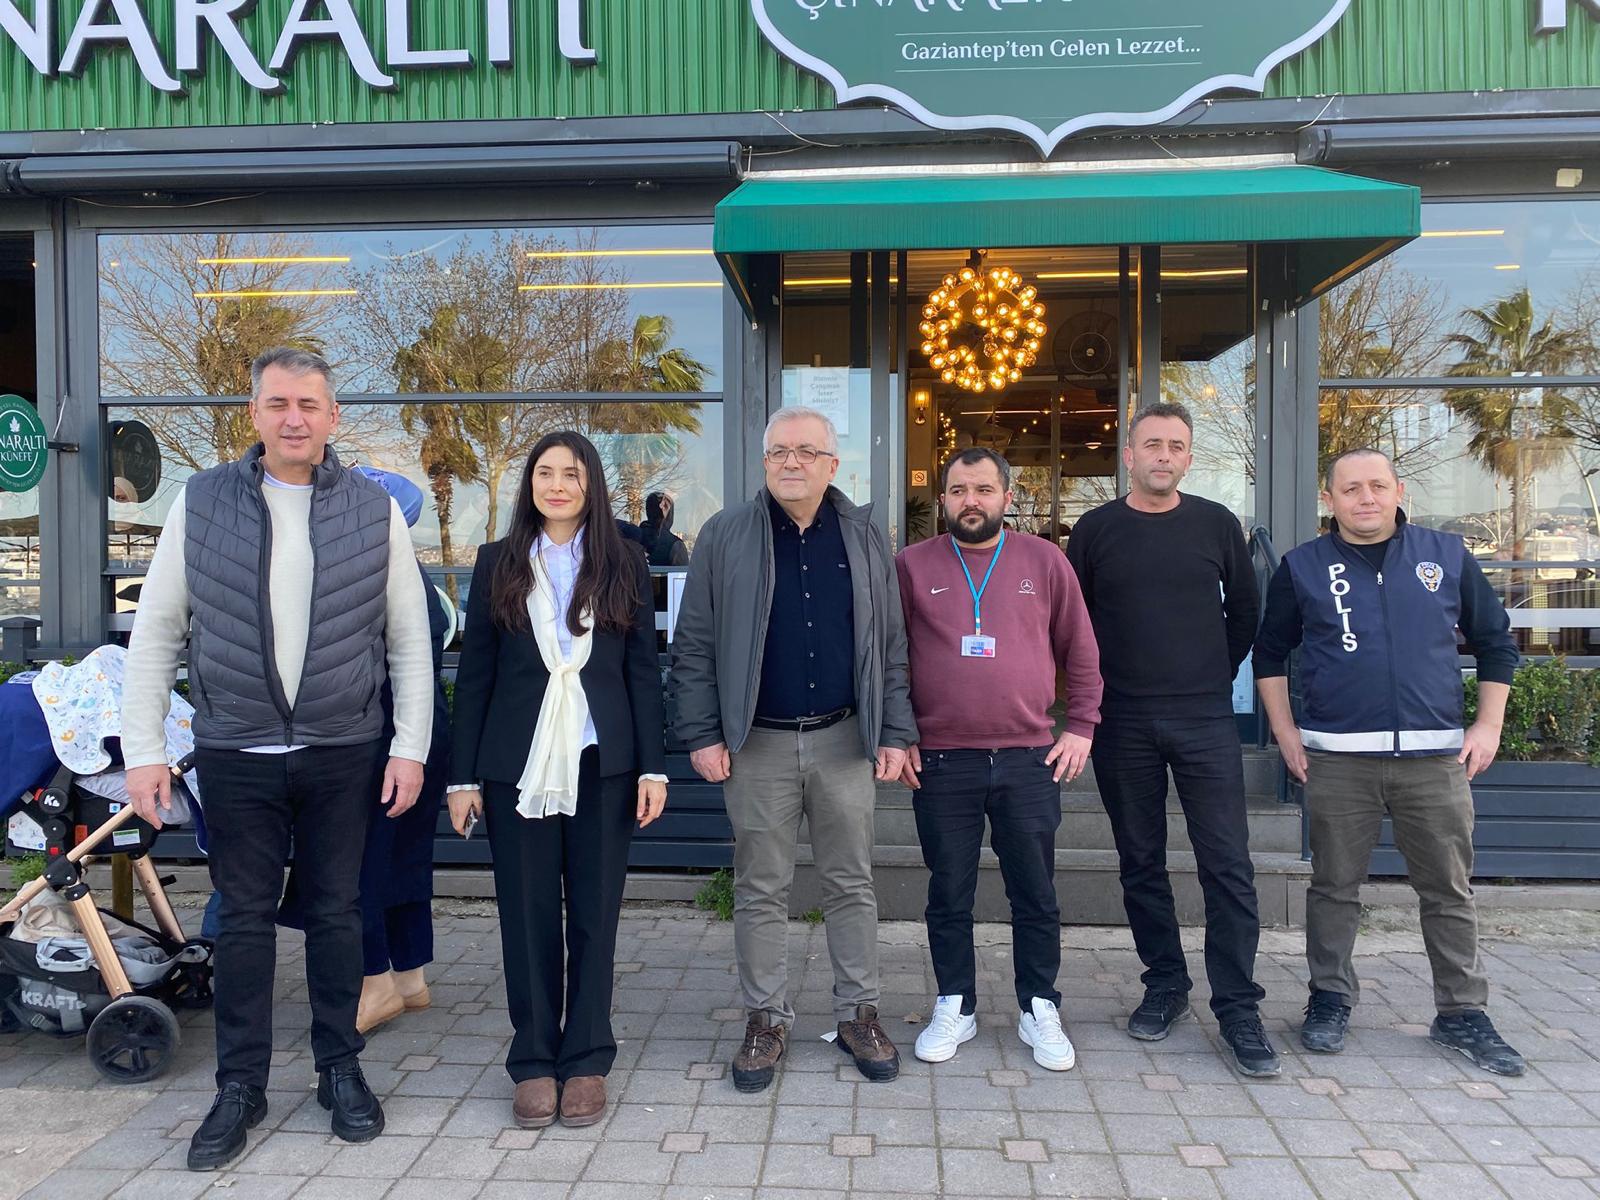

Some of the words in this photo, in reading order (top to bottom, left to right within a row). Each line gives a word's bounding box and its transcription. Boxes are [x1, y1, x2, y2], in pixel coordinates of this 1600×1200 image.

[1049, 39, 1110, 57] Gelen
[1116, 36, 1201, 56] Lezzet...
[0, 451, 33, 462] KÜNEFE
[21, 990, 79, 1010] KRAFT
